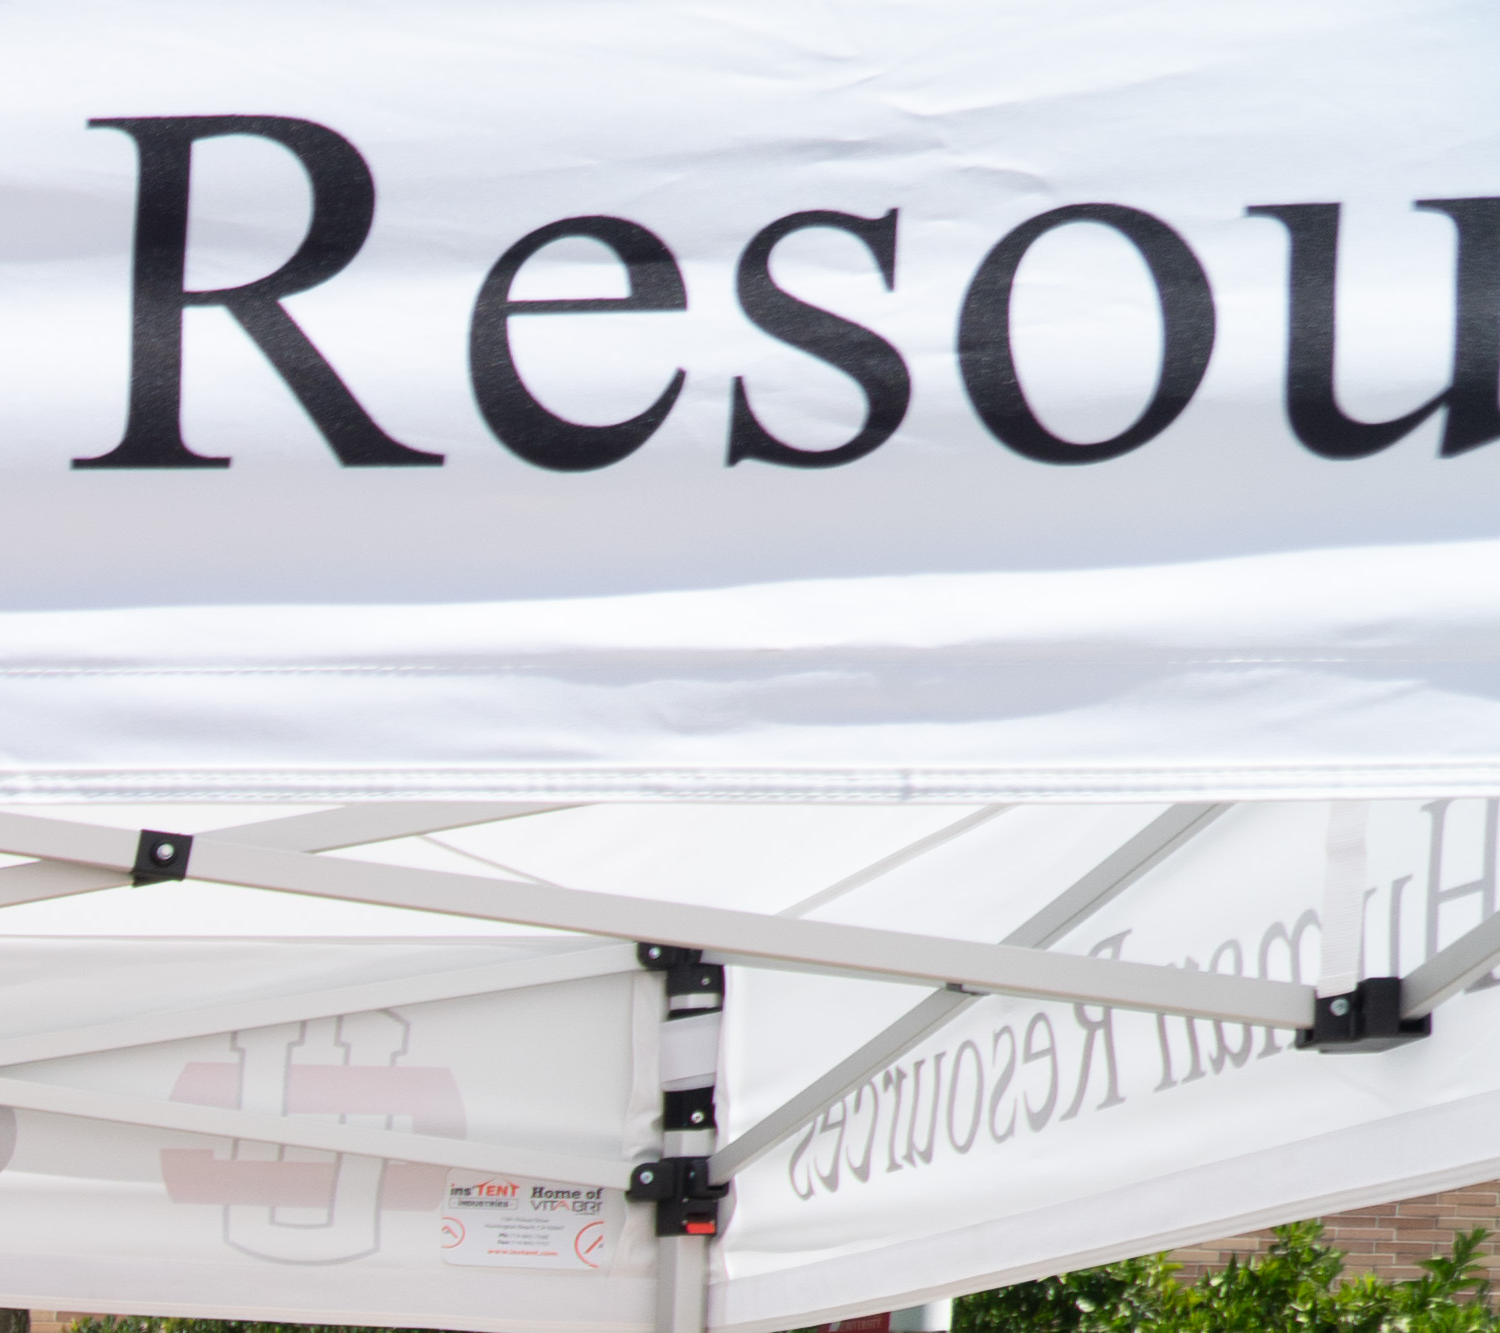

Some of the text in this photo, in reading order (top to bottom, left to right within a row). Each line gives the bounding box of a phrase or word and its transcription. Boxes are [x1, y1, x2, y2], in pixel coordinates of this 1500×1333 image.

[68, 112, 1500, 472] Resou
[531, 1187, 603, 1199] Home of
